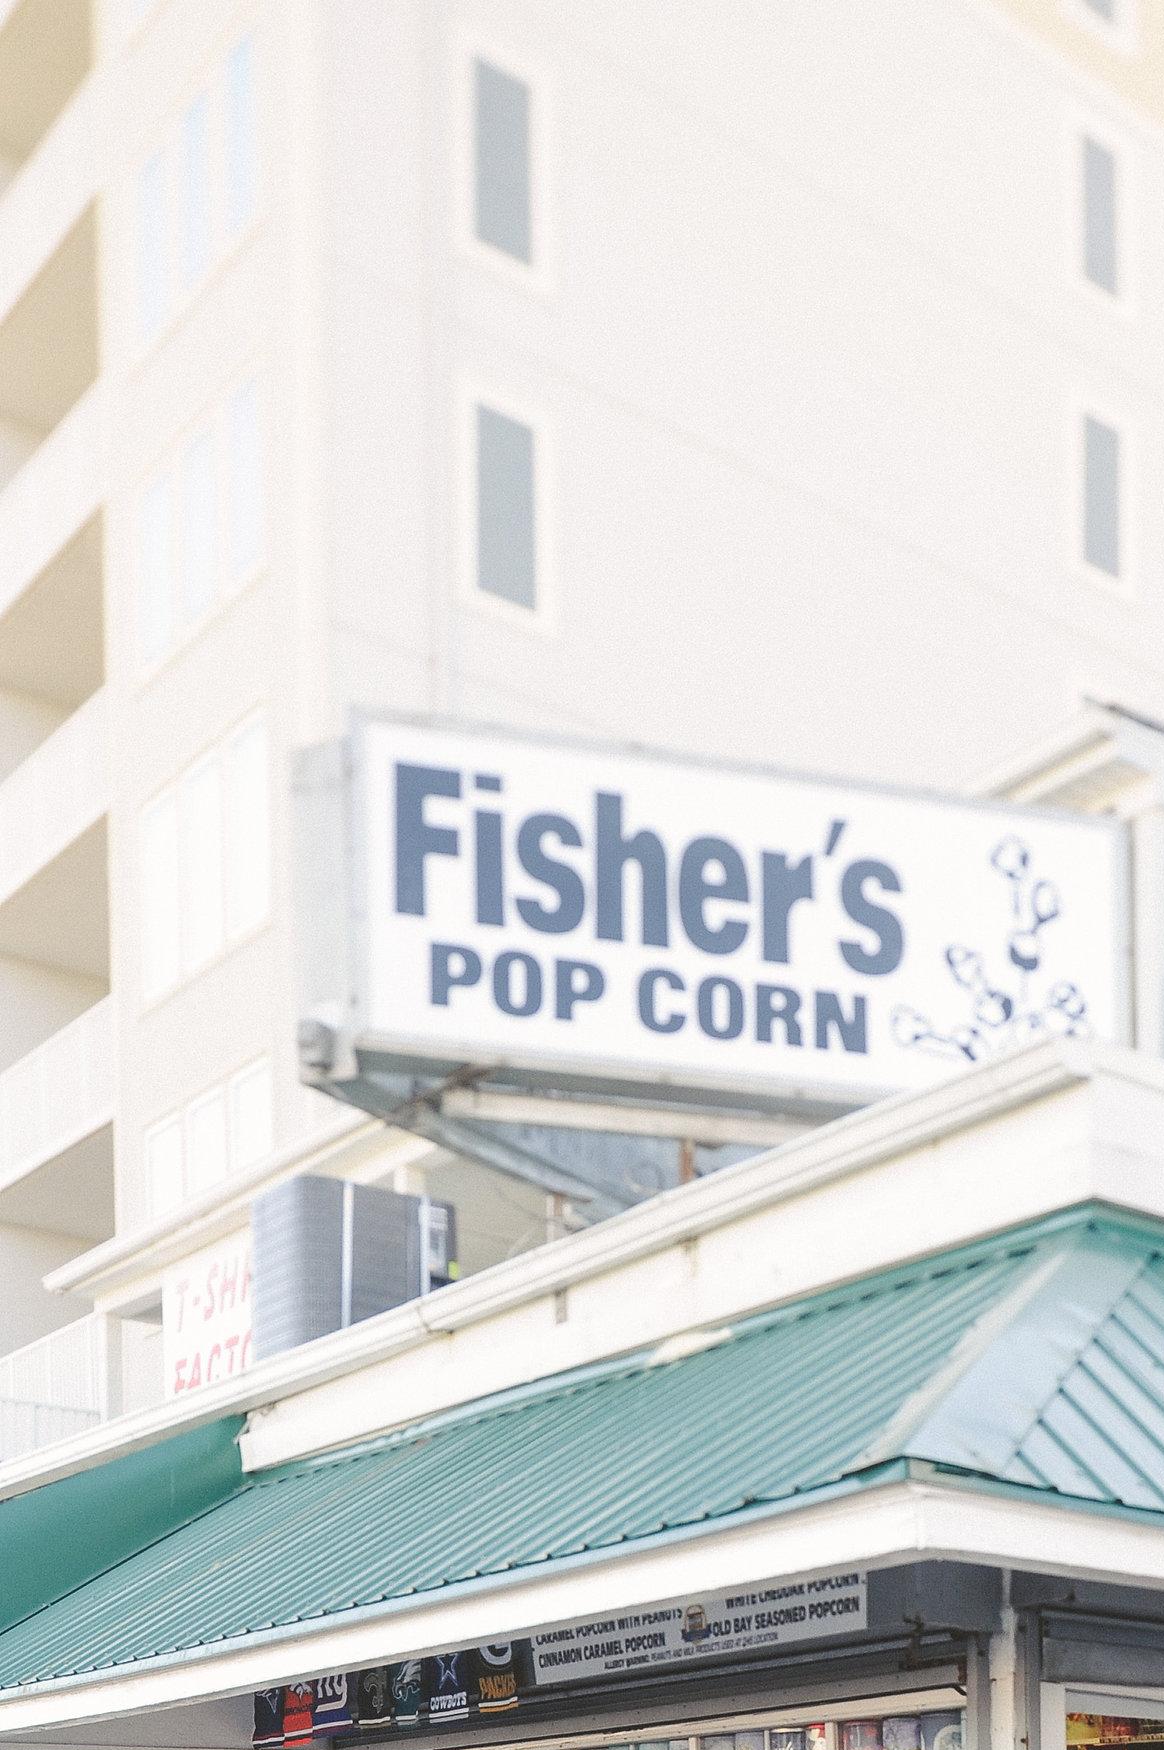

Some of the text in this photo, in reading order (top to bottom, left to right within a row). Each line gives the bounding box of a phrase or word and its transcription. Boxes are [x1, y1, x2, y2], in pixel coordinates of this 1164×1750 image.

[393, 761, 905, 977] Fisher's
[430, 943, 870, 1055] POP CORN
[806, 1573, 859, 1594] POPCORN
[535, 1607, 683, 1646] CARAMEL POPCORN WITH PEANUTS
[712, 1596, 859, 1637] OLD BAY SEASONED POPCORN
[538, 1631, 666, 1668] CINNAMON CARAMEL POPCORN
[431, 1691, 468, 1711] COWBOYS
